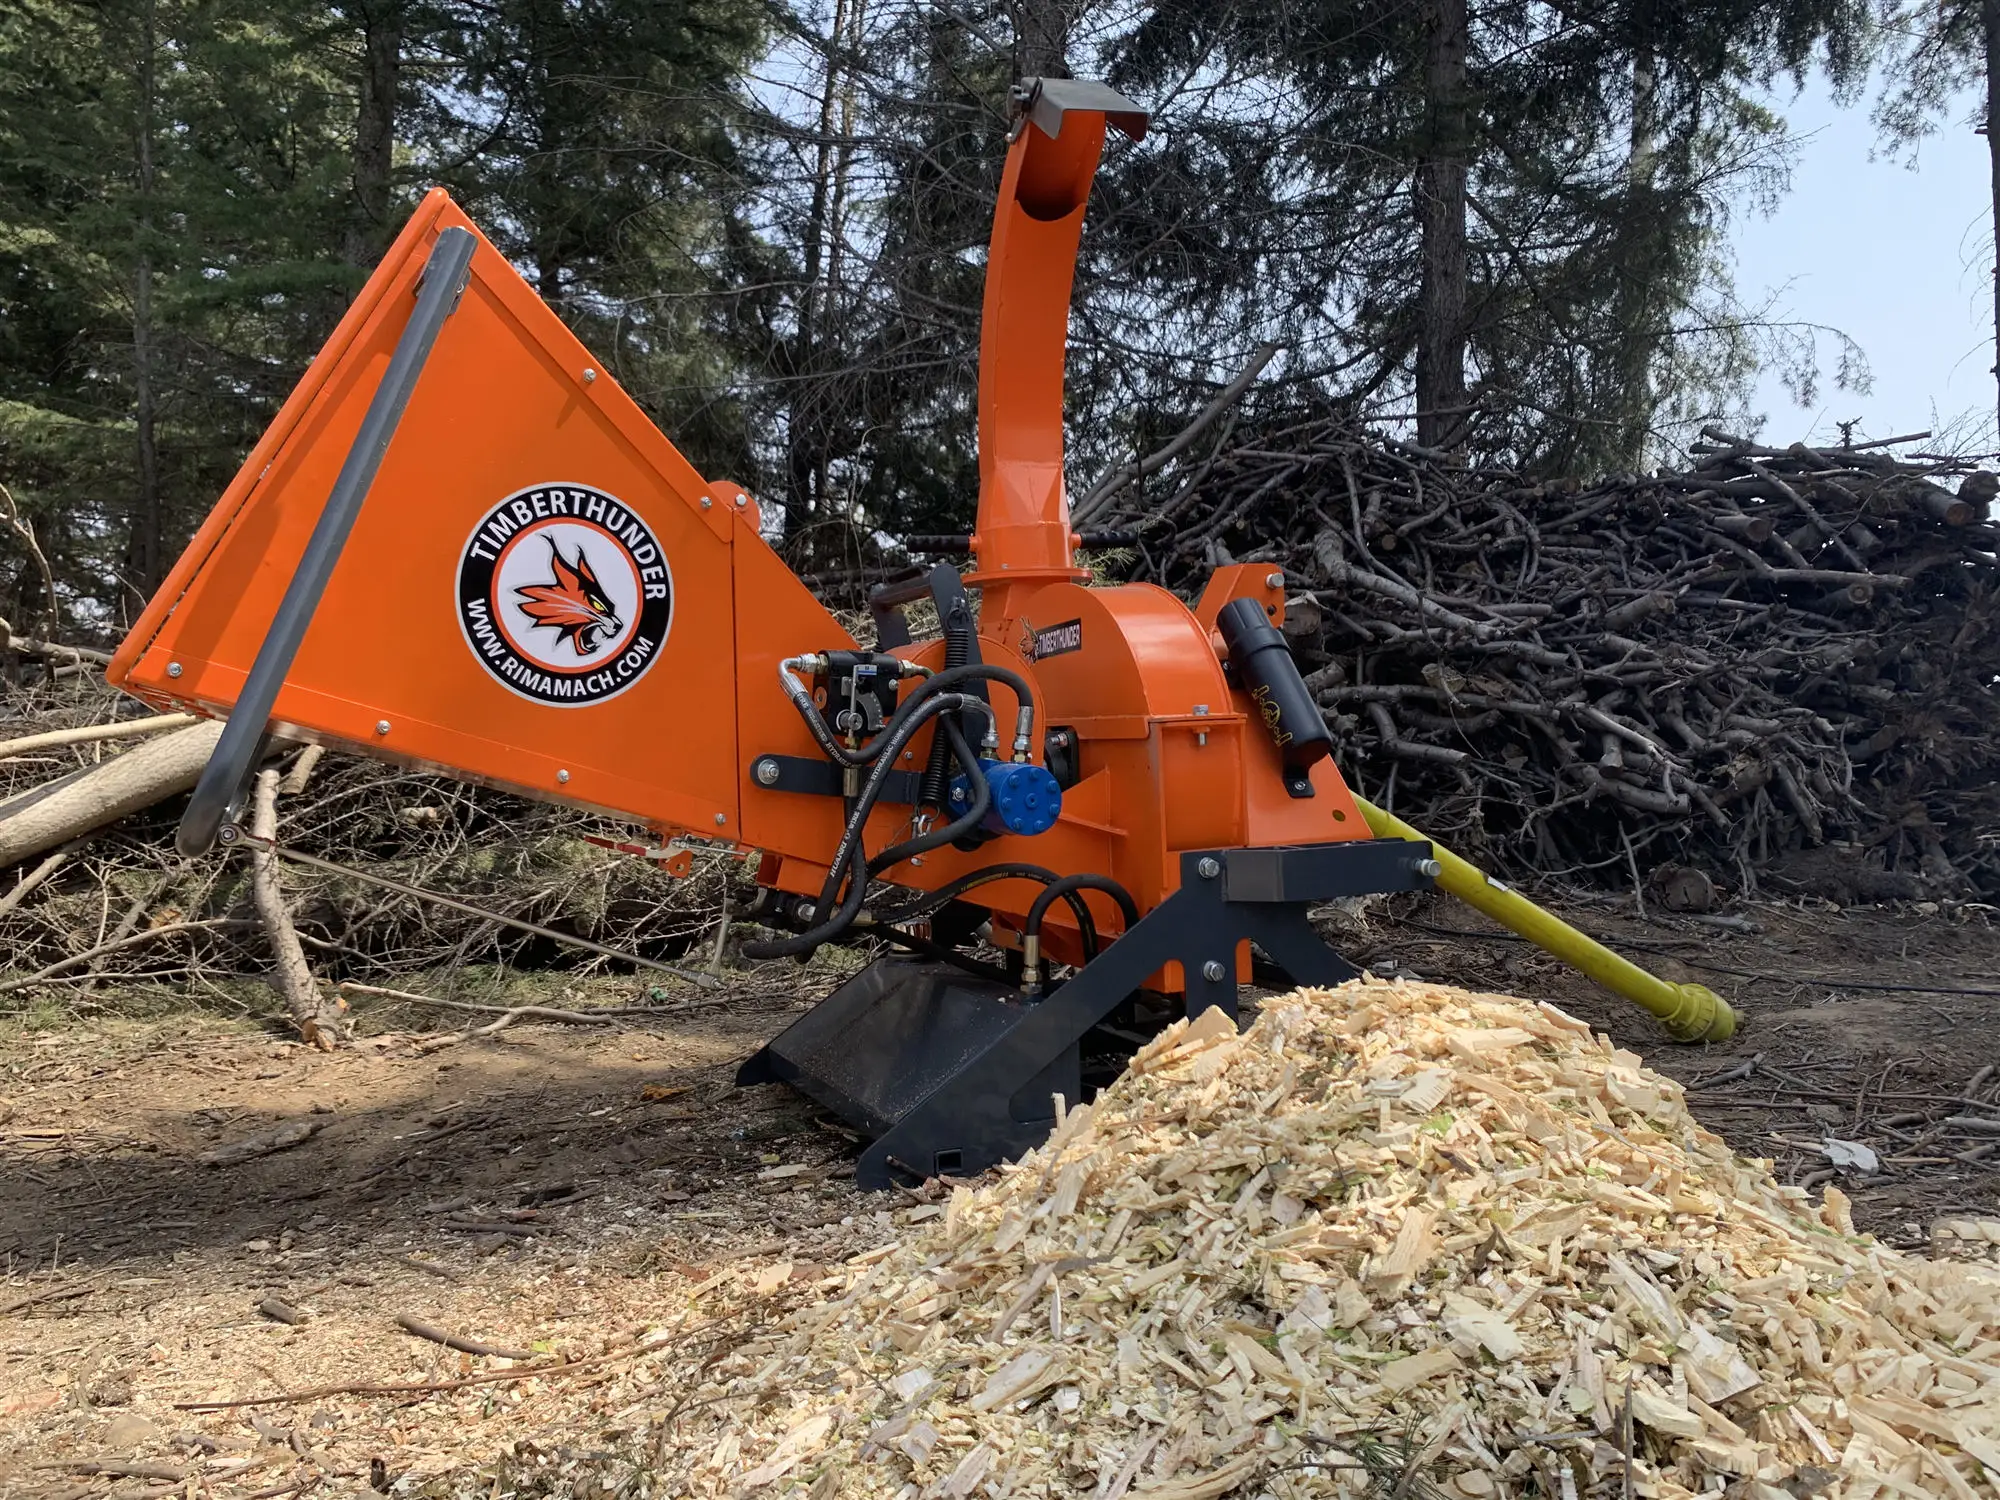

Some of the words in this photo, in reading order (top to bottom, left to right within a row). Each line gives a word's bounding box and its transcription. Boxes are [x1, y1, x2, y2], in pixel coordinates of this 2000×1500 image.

[470, 490, 667, 600] TIMBERTHUNDER
[467, 598, 655, 697] WWW.RIMAMACH.COM
[1039, 623, 1081, 655] TIMBERTHUNDER
[870, 744, 894, 781] HYDRAULIC
